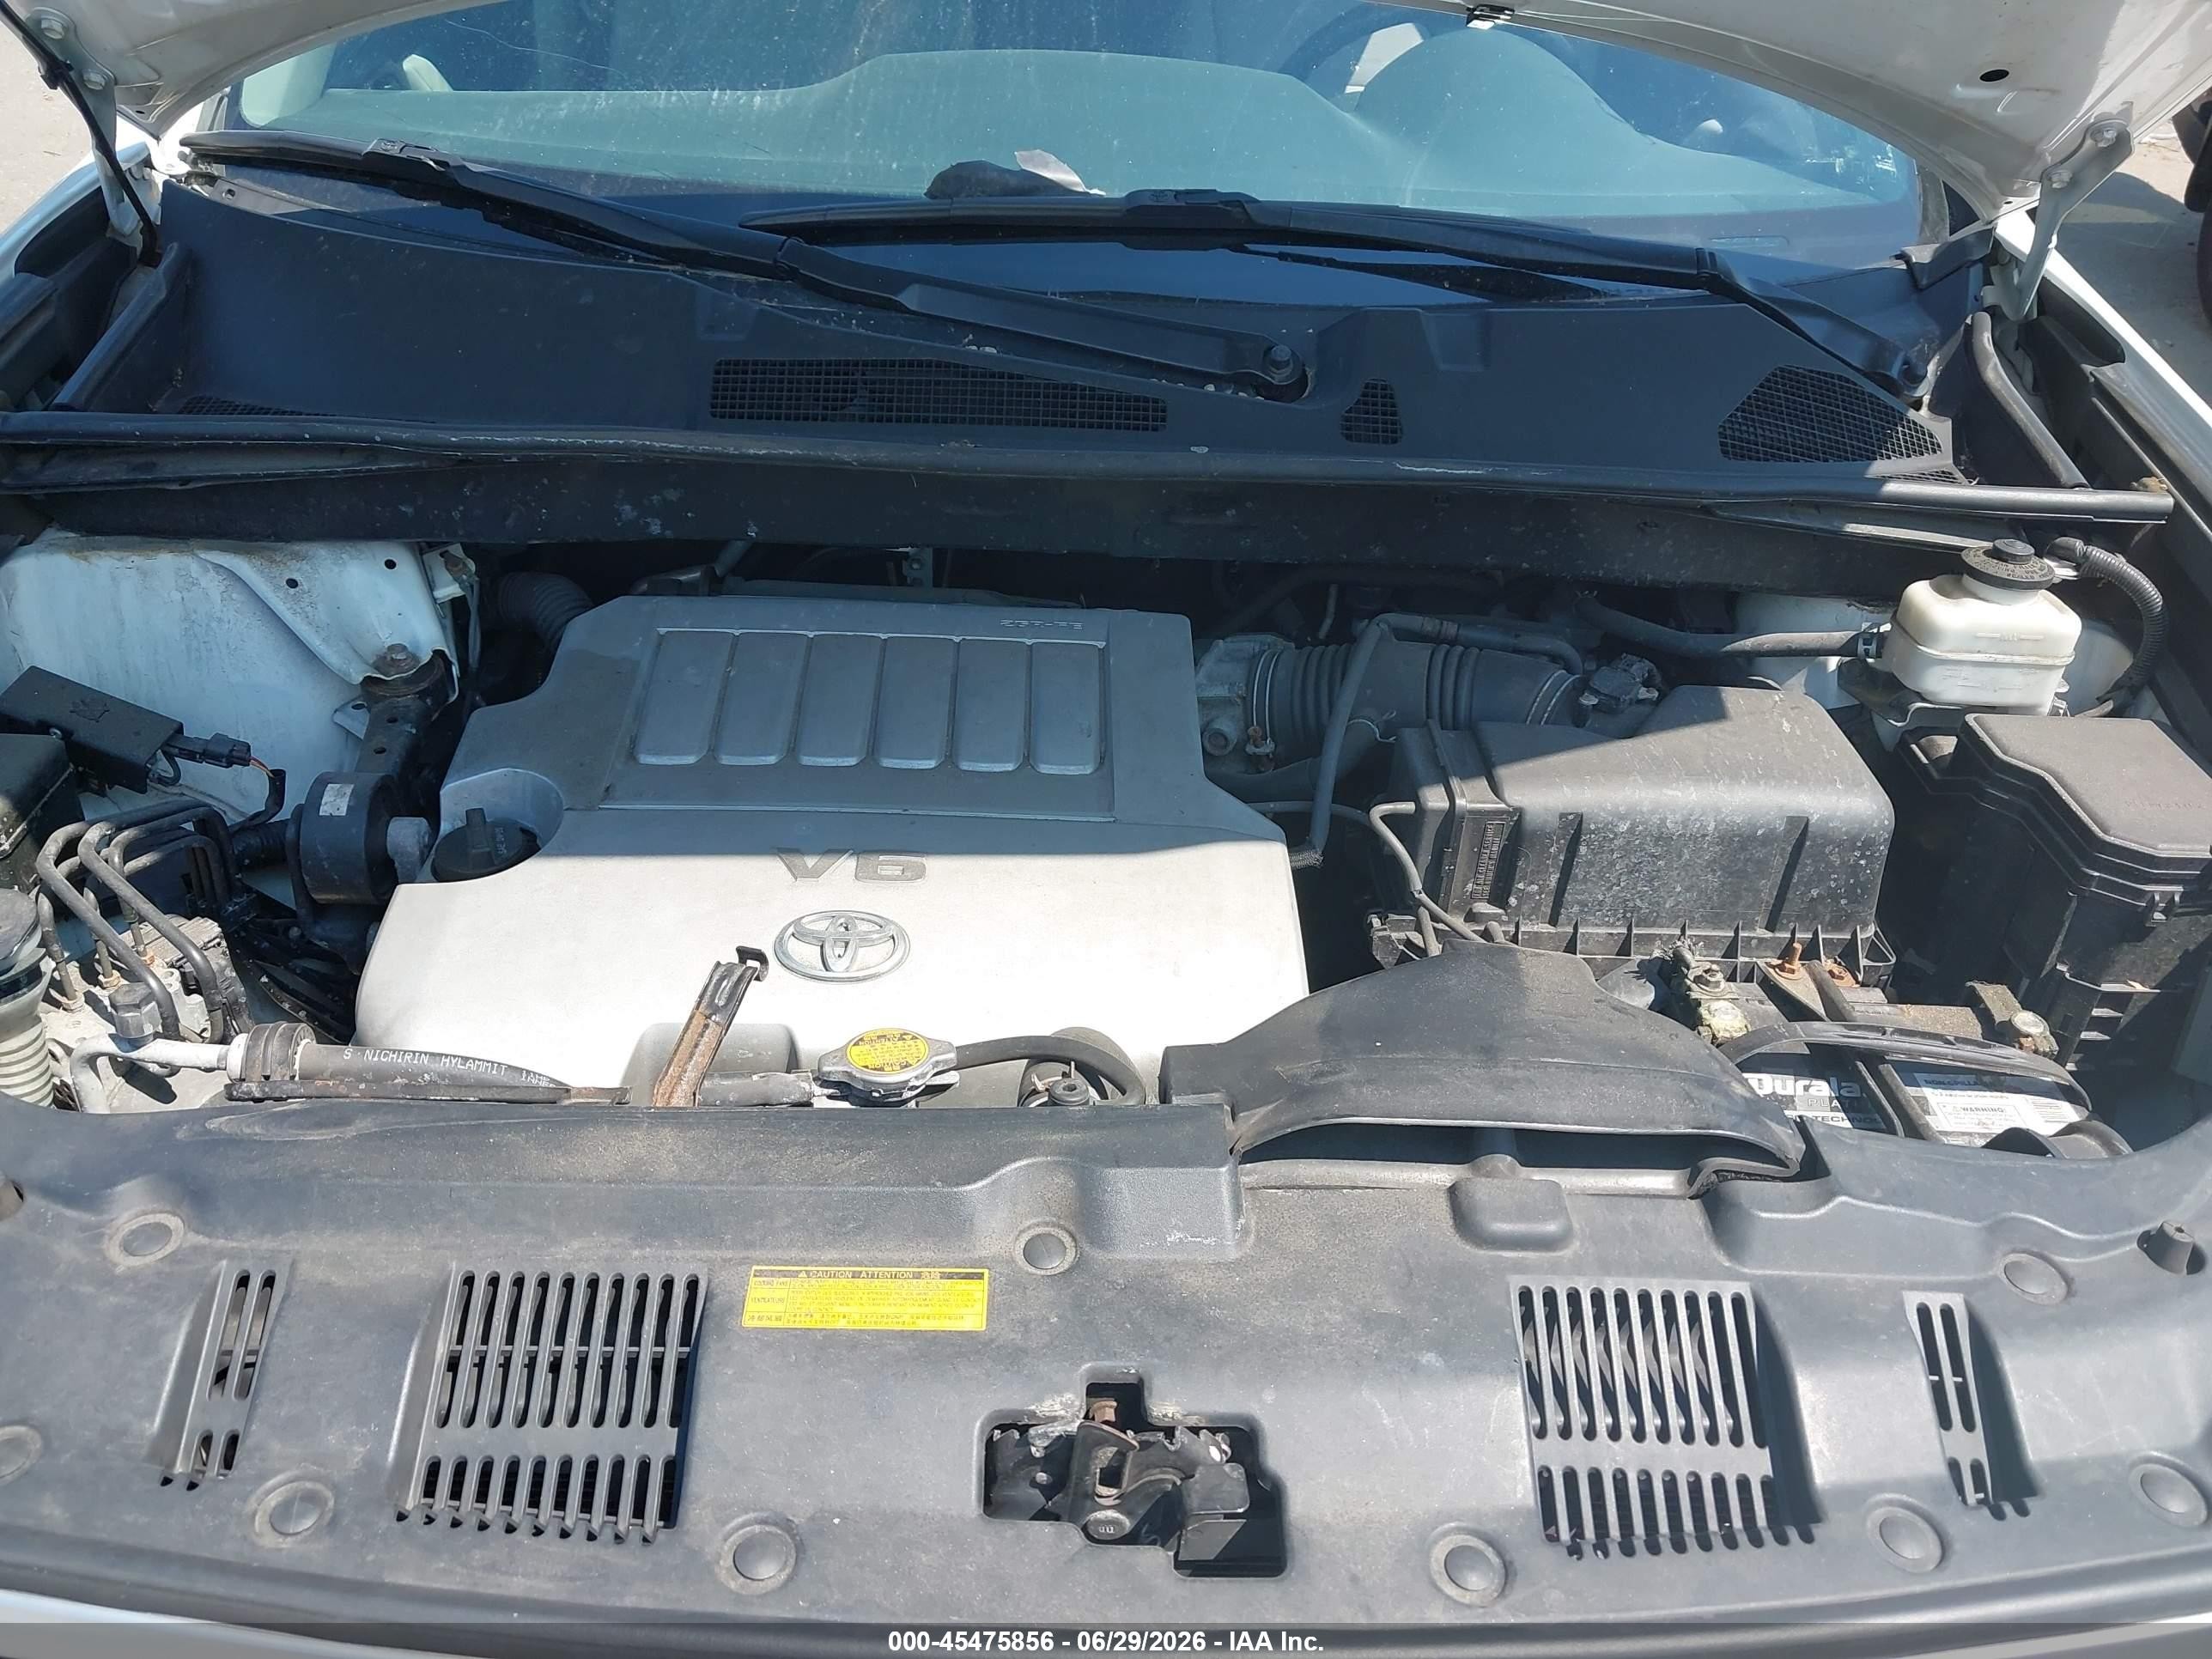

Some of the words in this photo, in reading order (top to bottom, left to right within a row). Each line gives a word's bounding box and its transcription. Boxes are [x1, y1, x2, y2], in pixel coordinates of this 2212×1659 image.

[776, 847, 927, 883] V6
[363, 1049, 429, 1065] NICHIRIN
[441, 1054, 508, 1076] HYLAMMIT
[1748, 1074, 1867, 1097] Durala
